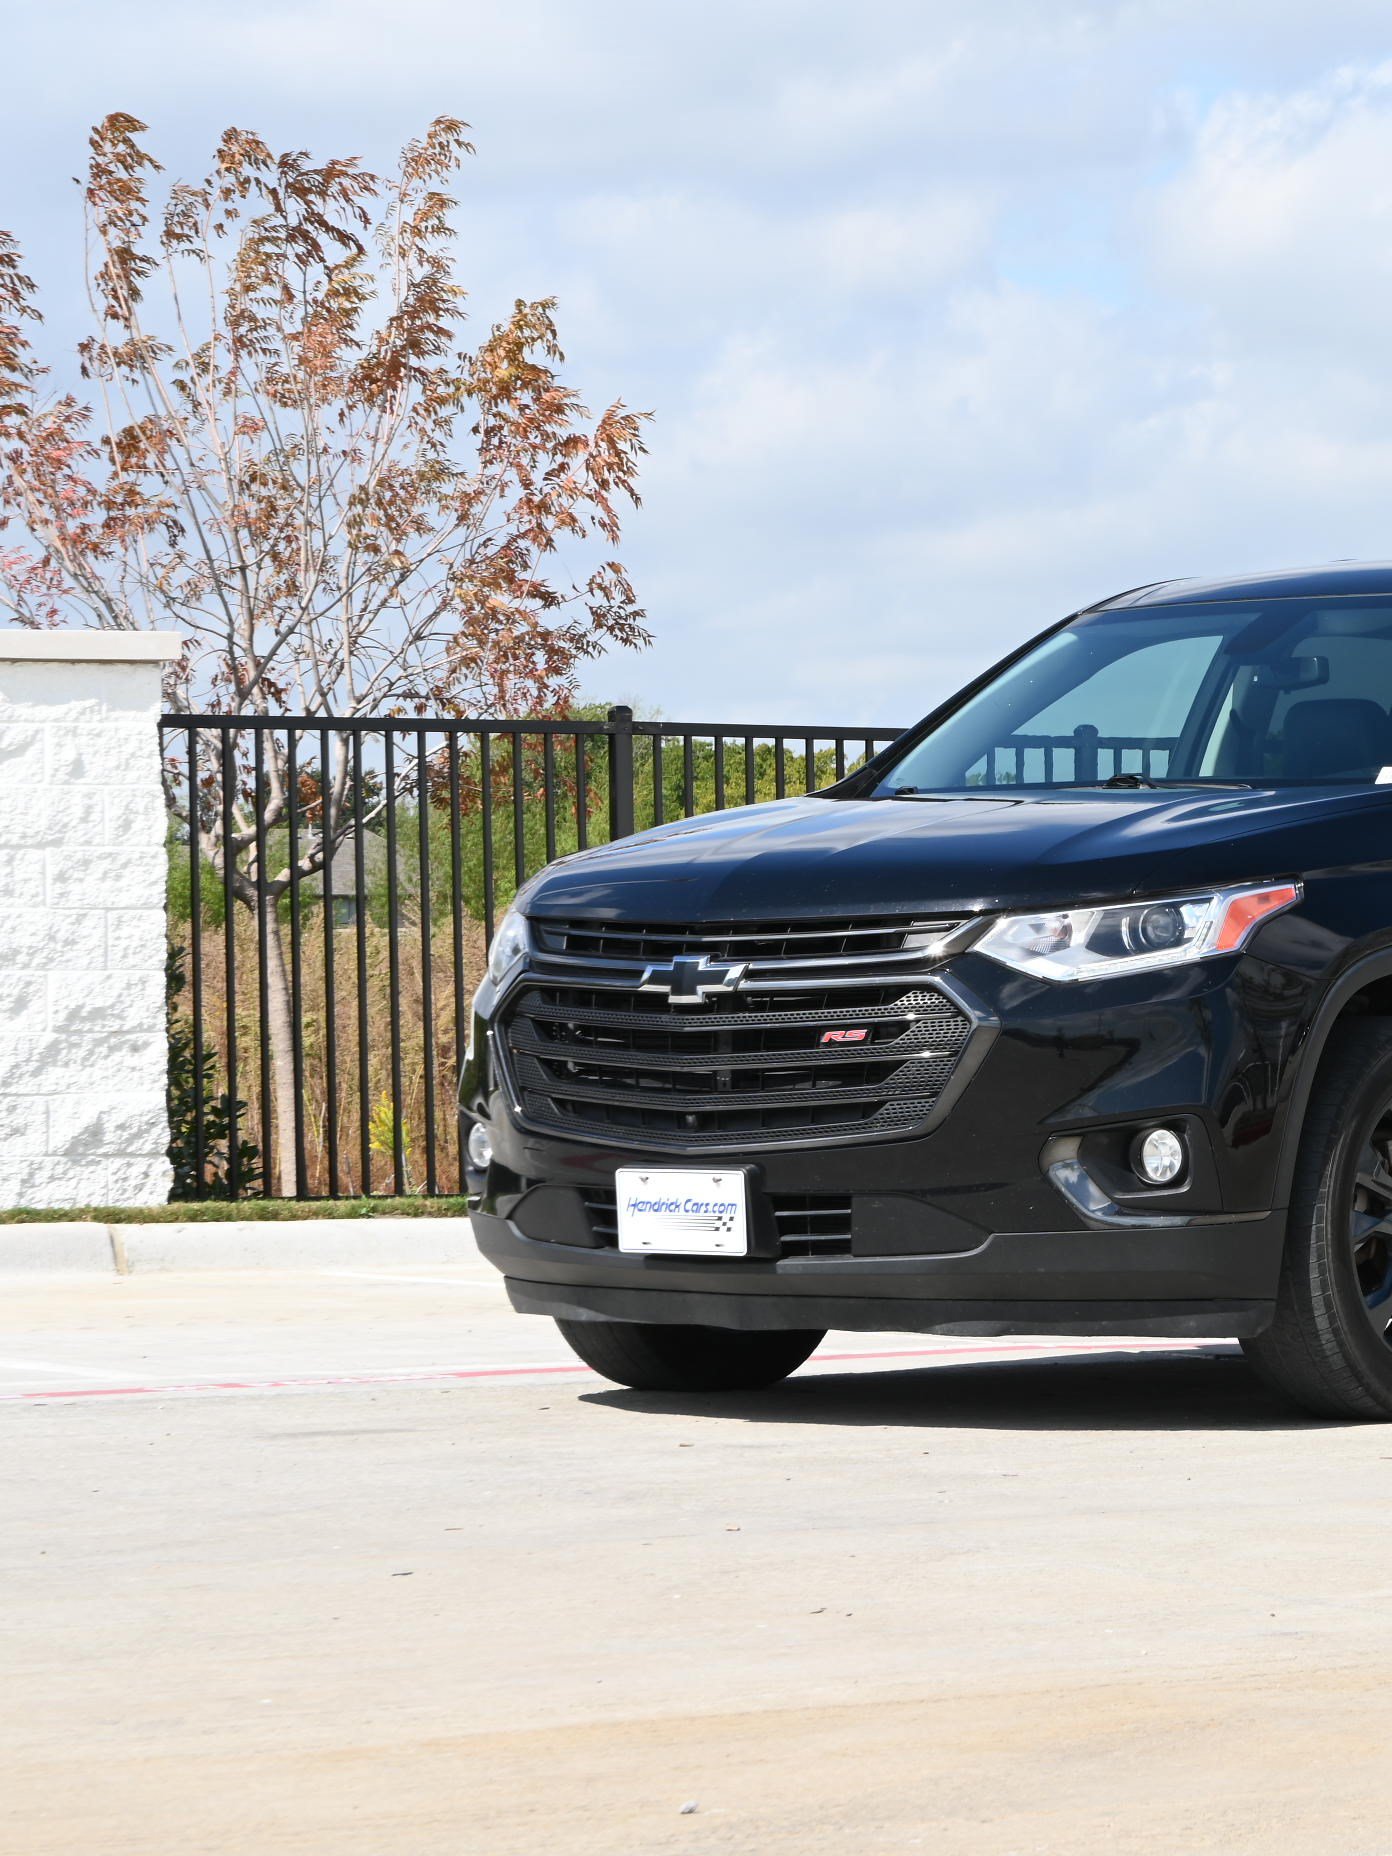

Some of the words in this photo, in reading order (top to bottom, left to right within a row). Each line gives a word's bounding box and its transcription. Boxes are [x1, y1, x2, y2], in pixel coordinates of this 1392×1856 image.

[820, 1029, 868, 1043] RS
[626, 1197, 682, 1216] Hendrick
[683, 1198, 737, 1214] Cars.com
